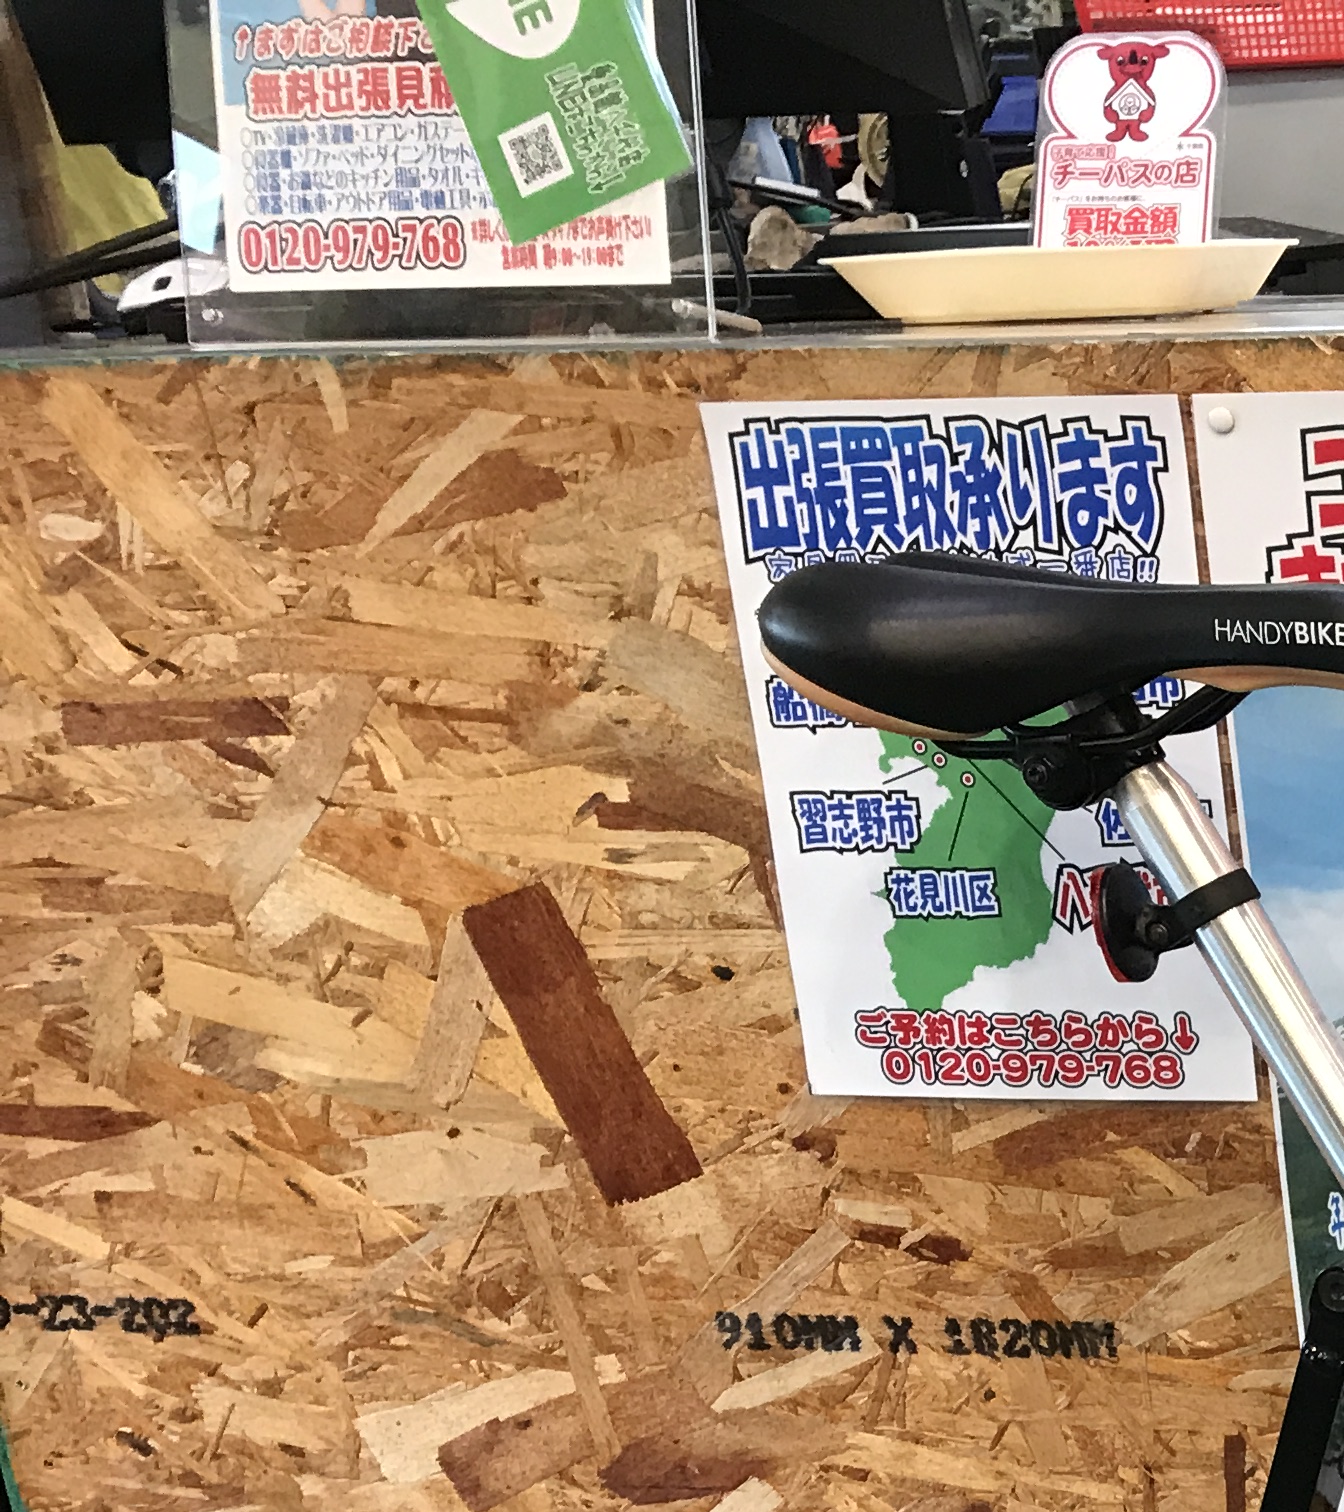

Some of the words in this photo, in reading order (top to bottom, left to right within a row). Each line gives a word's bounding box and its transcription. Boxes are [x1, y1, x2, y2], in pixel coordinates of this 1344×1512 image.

[1051, 157, 1203, 190] チーパスの店
[1065, 204, 1181, 236] 買取金額
[241, 217, 466, 272] 0120-979-768
[733, 418, 1165, 550] 出張買取承ります
[795, 794, 918, 850] 習志野市
[887, 868, 999, 917] 花見川区
[856, 1010, 1168, 1049] ご予約はこちらから
[884, 1051, 1184, 1087] 0120-979-768
[714, 1310, 863, 1354] 910MM
[882, 1313, 919, 1355] X
